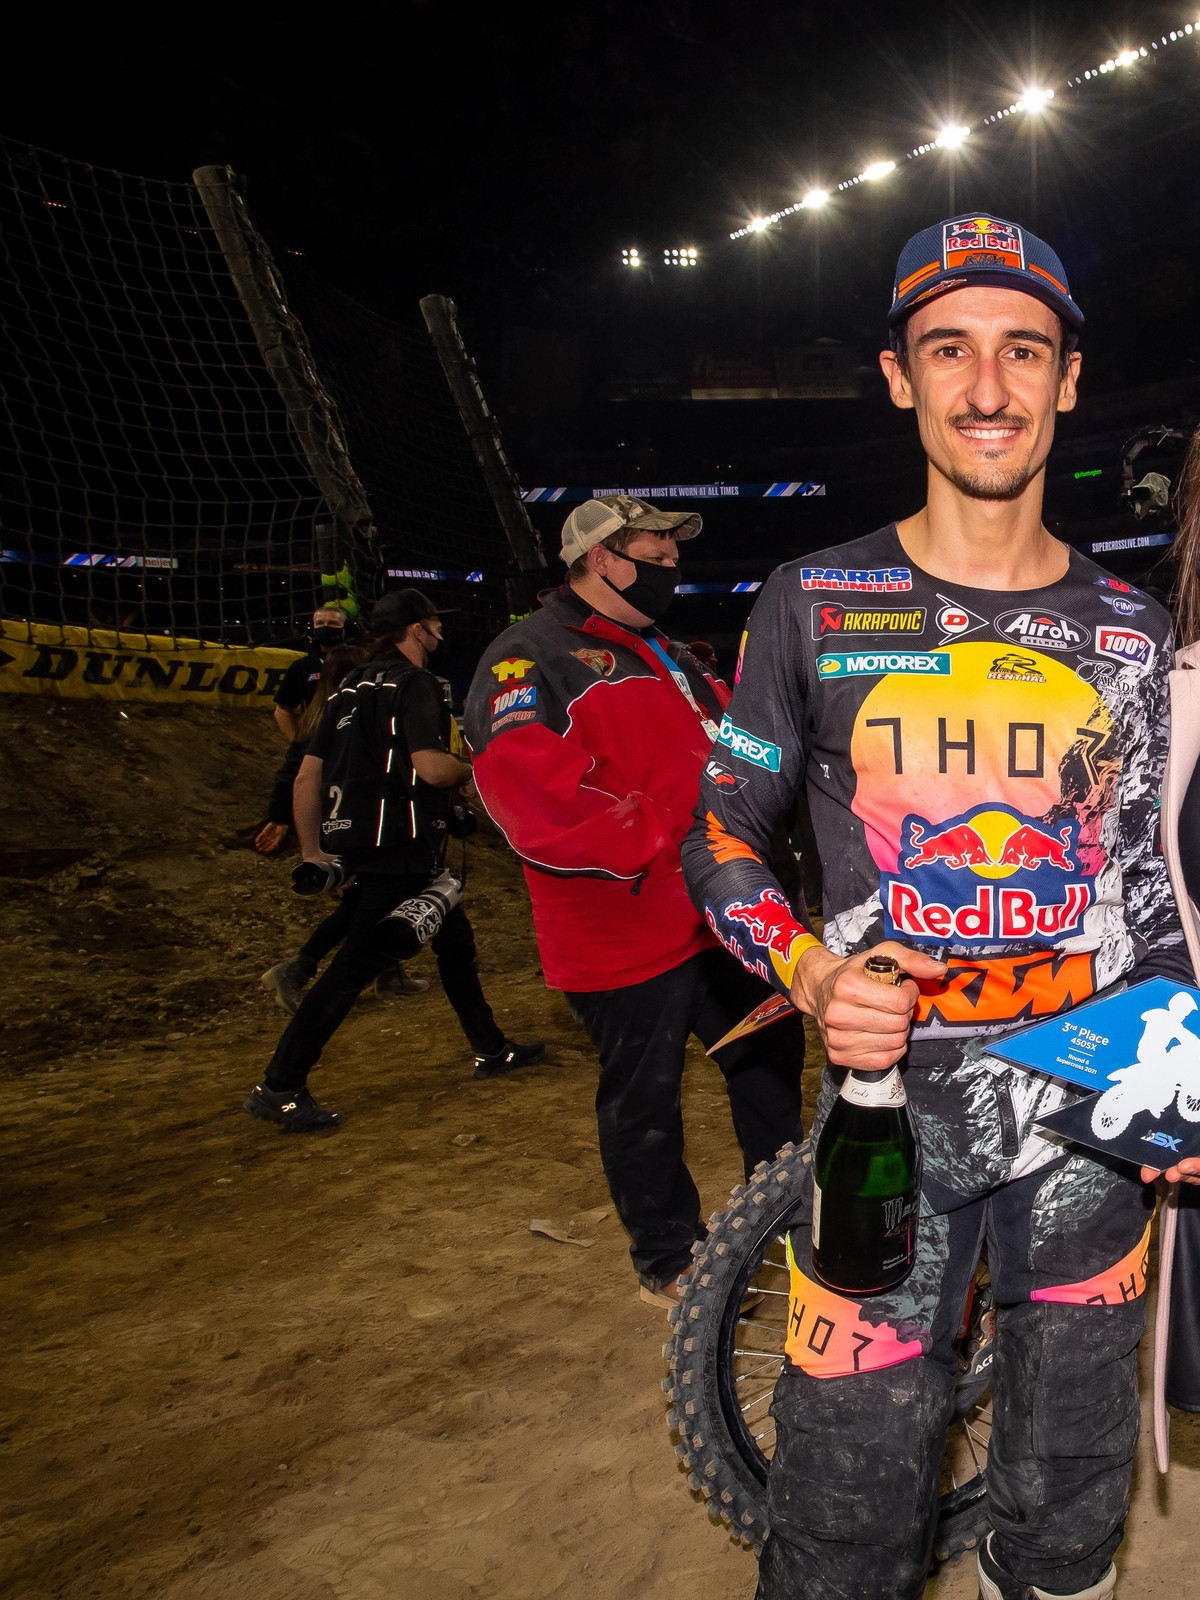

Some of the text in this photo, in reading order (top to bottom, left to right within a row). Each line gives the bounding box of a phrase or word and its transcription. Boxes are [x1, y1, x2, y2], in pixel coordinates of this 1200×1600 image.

[947, 233, 1020, 253] Red Bull
[627, 487, 651, 498] MASKS
[650, 487, 669, 497] MUST
[669, 487, 678, 496] BE
[678, 487, 698, 496] WORN
[699, 487, 706, 496] AT
[707, 487, 719, 496] ALL
[719, 486, 740, 496] TIMES
[1091, 536, 1150, 553] SUPERCROSSLIVE.COM
[801, 567, 912, 584] PARTS
[802, 578, 913, 592] UNLIMITED
[1114, 600, 1133, 612] FIM
[843, 610, 922, 631] AKRAPOVIČ
[1003, 613, 1081, 643] Airoh
[1025, 636, 1065, 648] HELMET
[1103, 634, 1149, 662] 100%
[846, 655, 941, 673] MOTOREX
[986, 672, 1047, 684] RENTHAL
[493, 686, 533, 716] 100%
[329, 785, 343, 820] 2
[891, 882, 1091, 937] Red Bull
[912, 951, 1096, 1022] KTM
[1061, 1021, 1110, 1046] 3rd Place
[1070, 1037, 1098, 1052] 450SX
[1055, 1056, 1098, 1075] Supercross 2021
[1067, 1053, 1086, 1065] Round
[1151, 1131, 1183, 1153] SX
